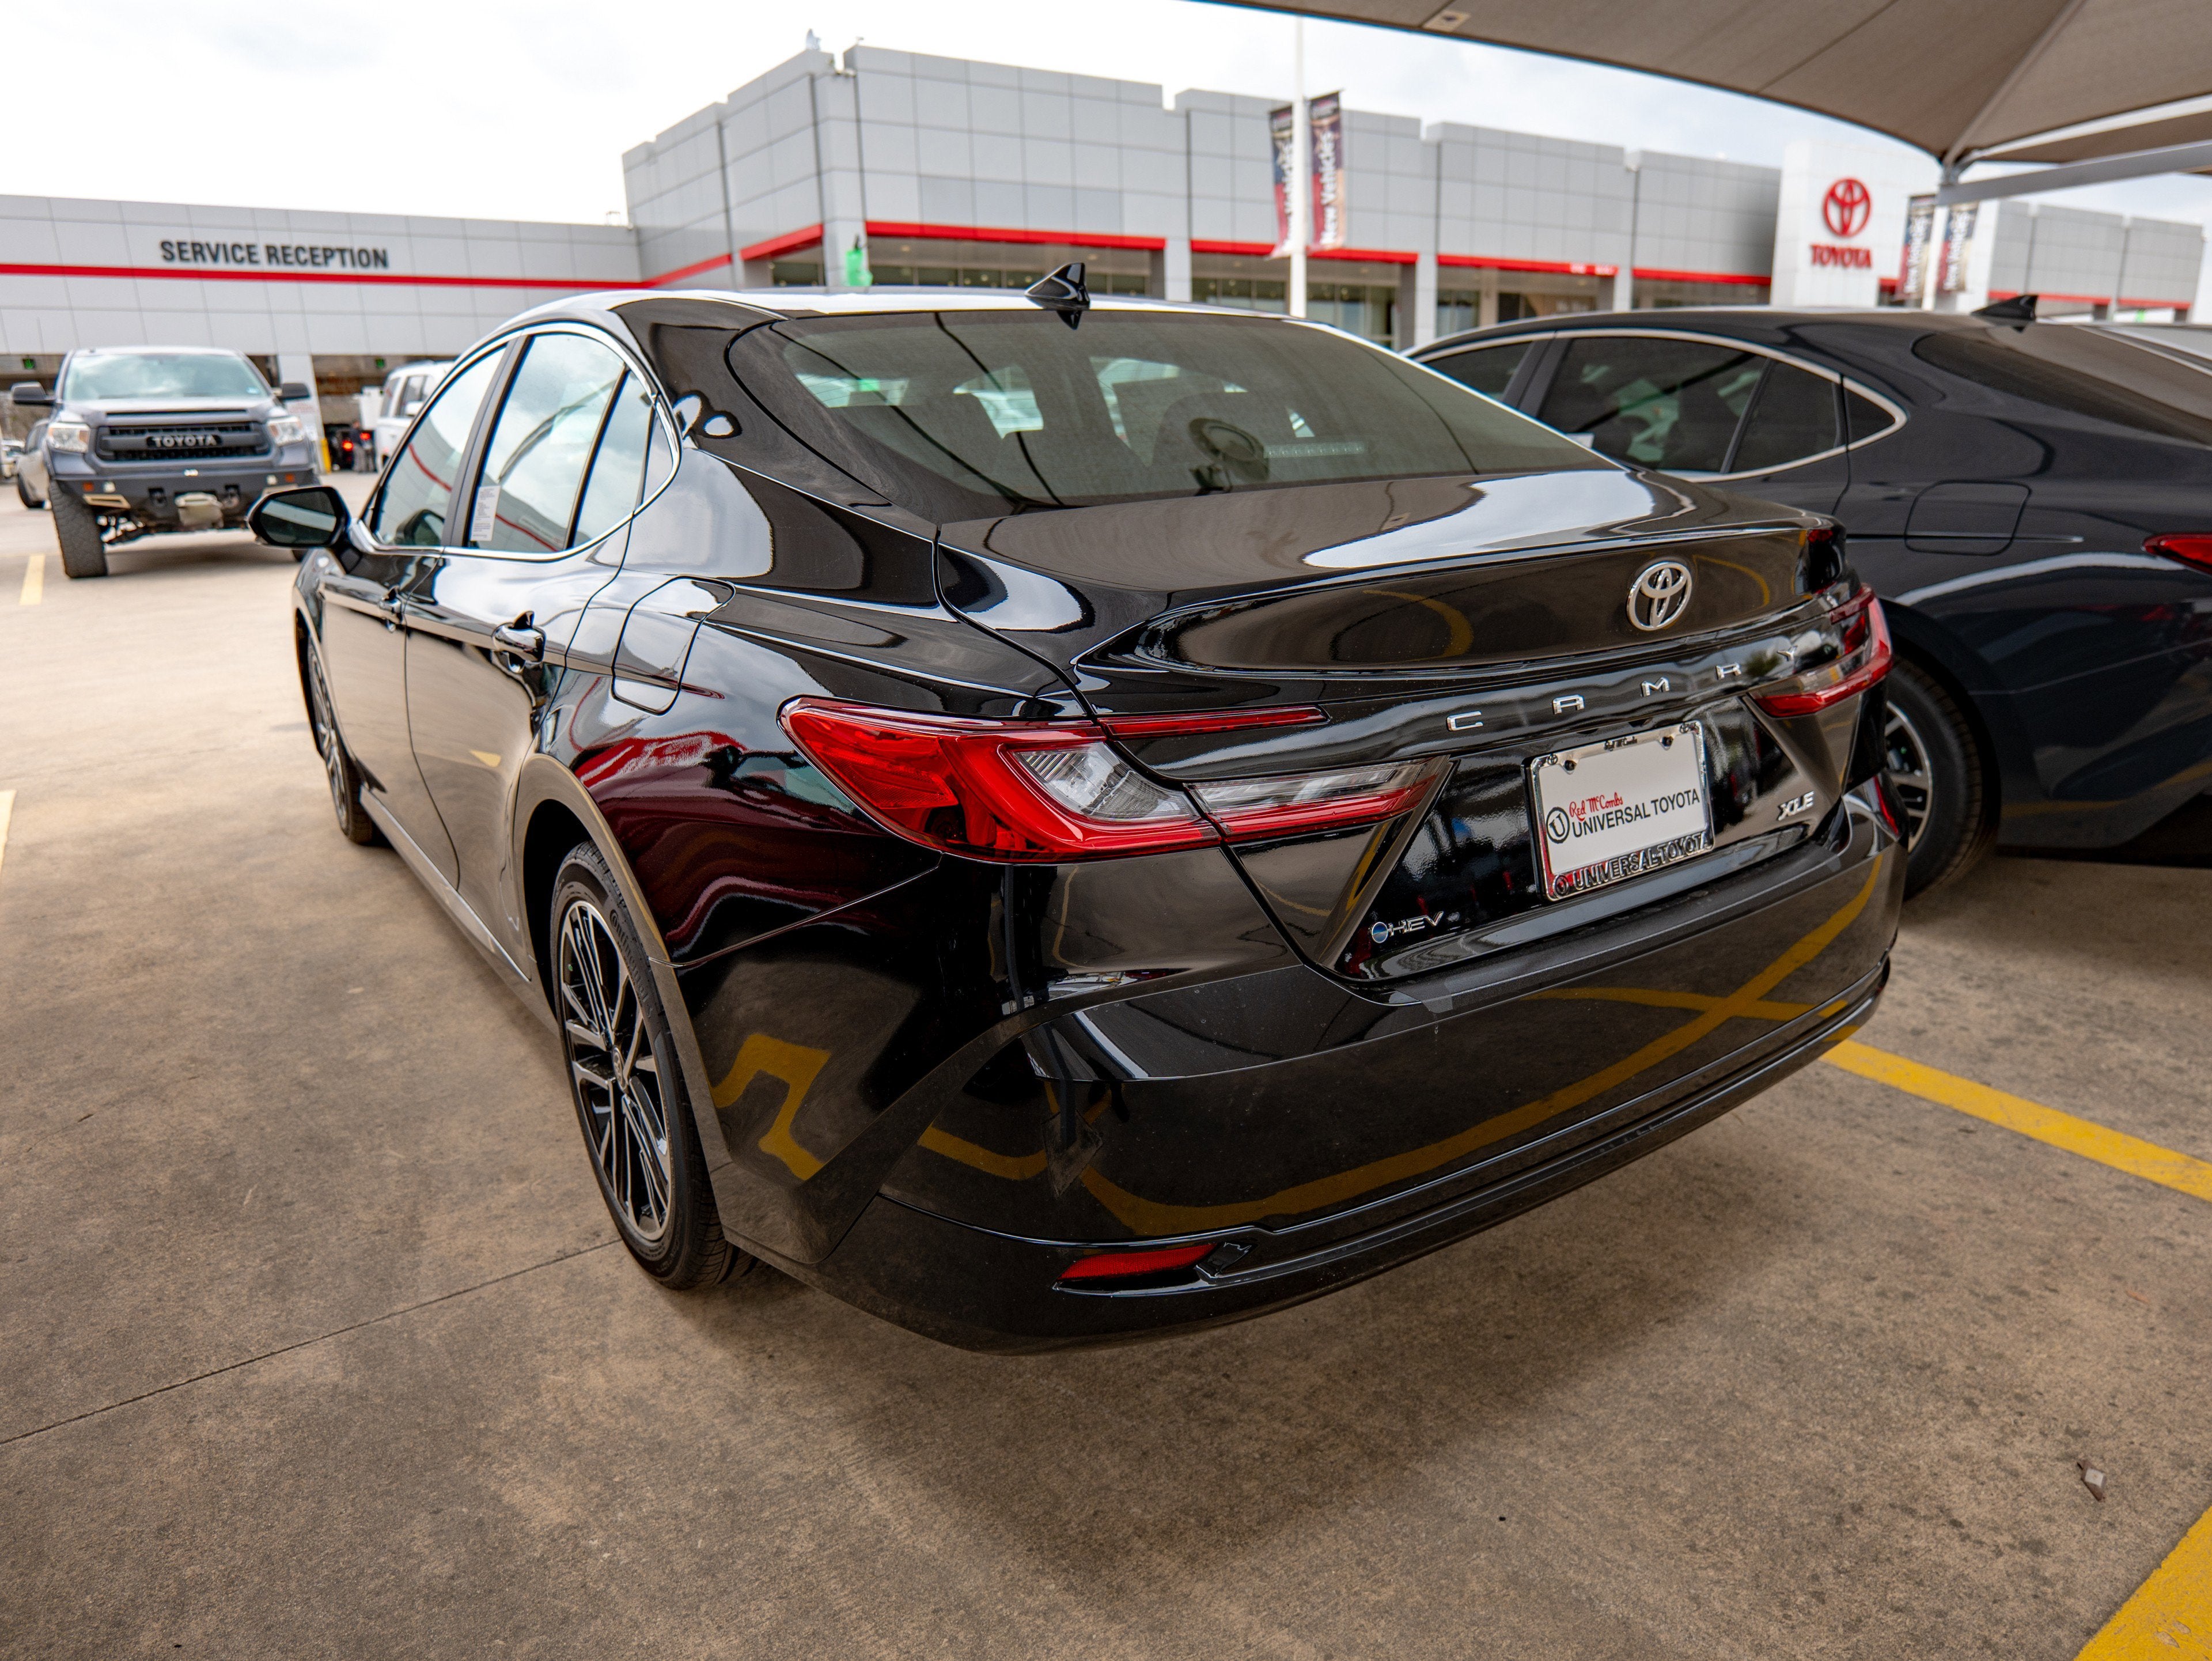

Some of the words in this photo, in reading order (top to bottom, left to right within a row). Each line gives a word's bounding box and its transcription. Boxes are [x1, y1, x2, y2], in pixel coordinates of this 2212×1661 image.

[1318, 131, 1336, 206] Vehicles
[1320, 205, 1337, 244] New
[1946, 211, 1970, 264] Vehicles
[160, 241, 260, 264] SERVICE
[266, 244, 389, 268] RECEPTION
[1810, 244, 1873, 269] TOYOTA
[151, 434, 217, 448] TOYOTA
[1446, 645, 1797, 732] CAMRY
[1569, 801, 1586, 822] Red
[1586, 792, 1623, 813] McCombs
[1571, 804, 1651, 838] UNIVERSAL
[1651, 788, 1700, 815] TOYOTA
[1778, 790, 1815, 822] XLE
[1572, 848, 1659, 891] UNIVERSAL
[1657, 830, 1713, 864] TOYOTA
[1388, 911, 1444, 937] HEV
